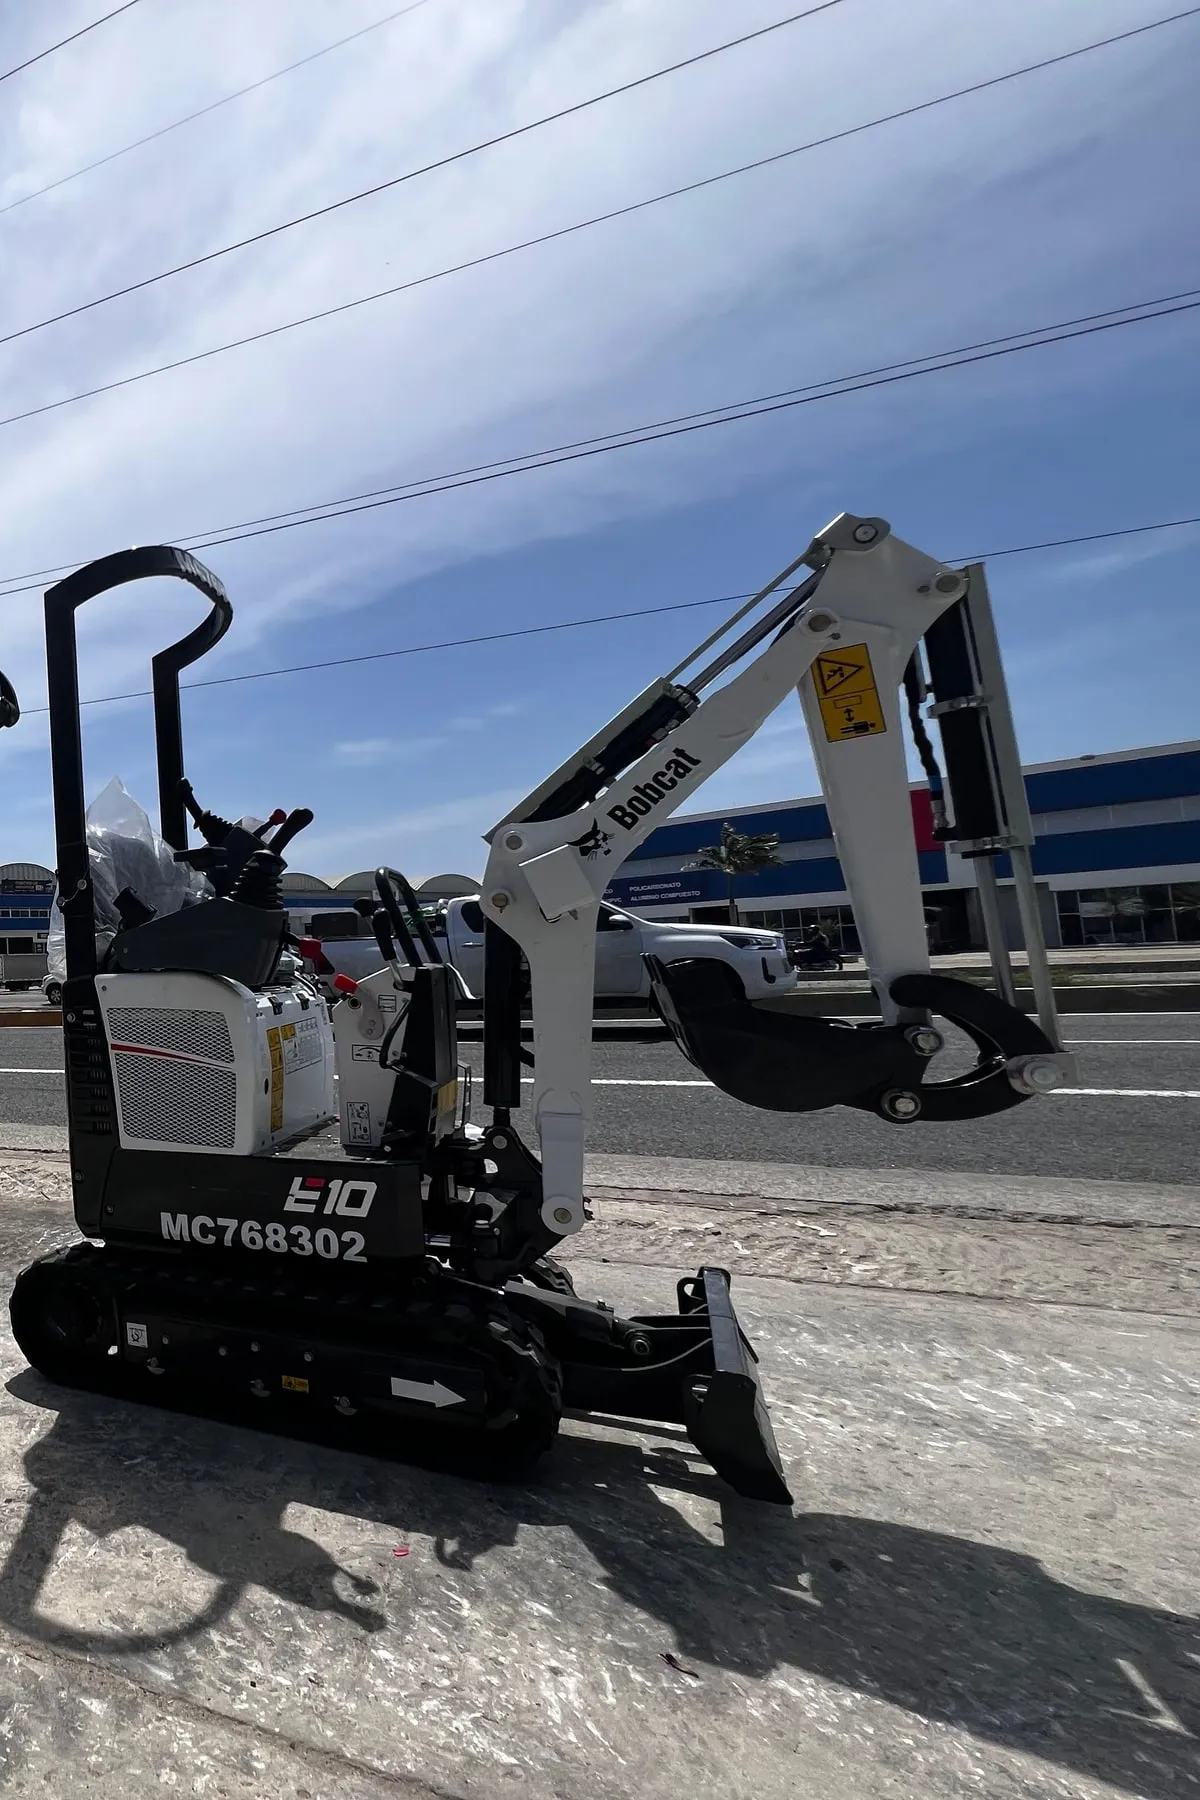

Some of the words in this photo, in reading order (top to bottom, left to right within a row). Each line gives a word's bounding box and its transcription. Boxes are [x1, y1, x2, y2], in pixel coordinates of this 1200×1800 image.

[606, 747, 702, 831] Bobcat
[283, 1176, 378, 1218] E10
[159, 1211, 369, 1263] MC768302
